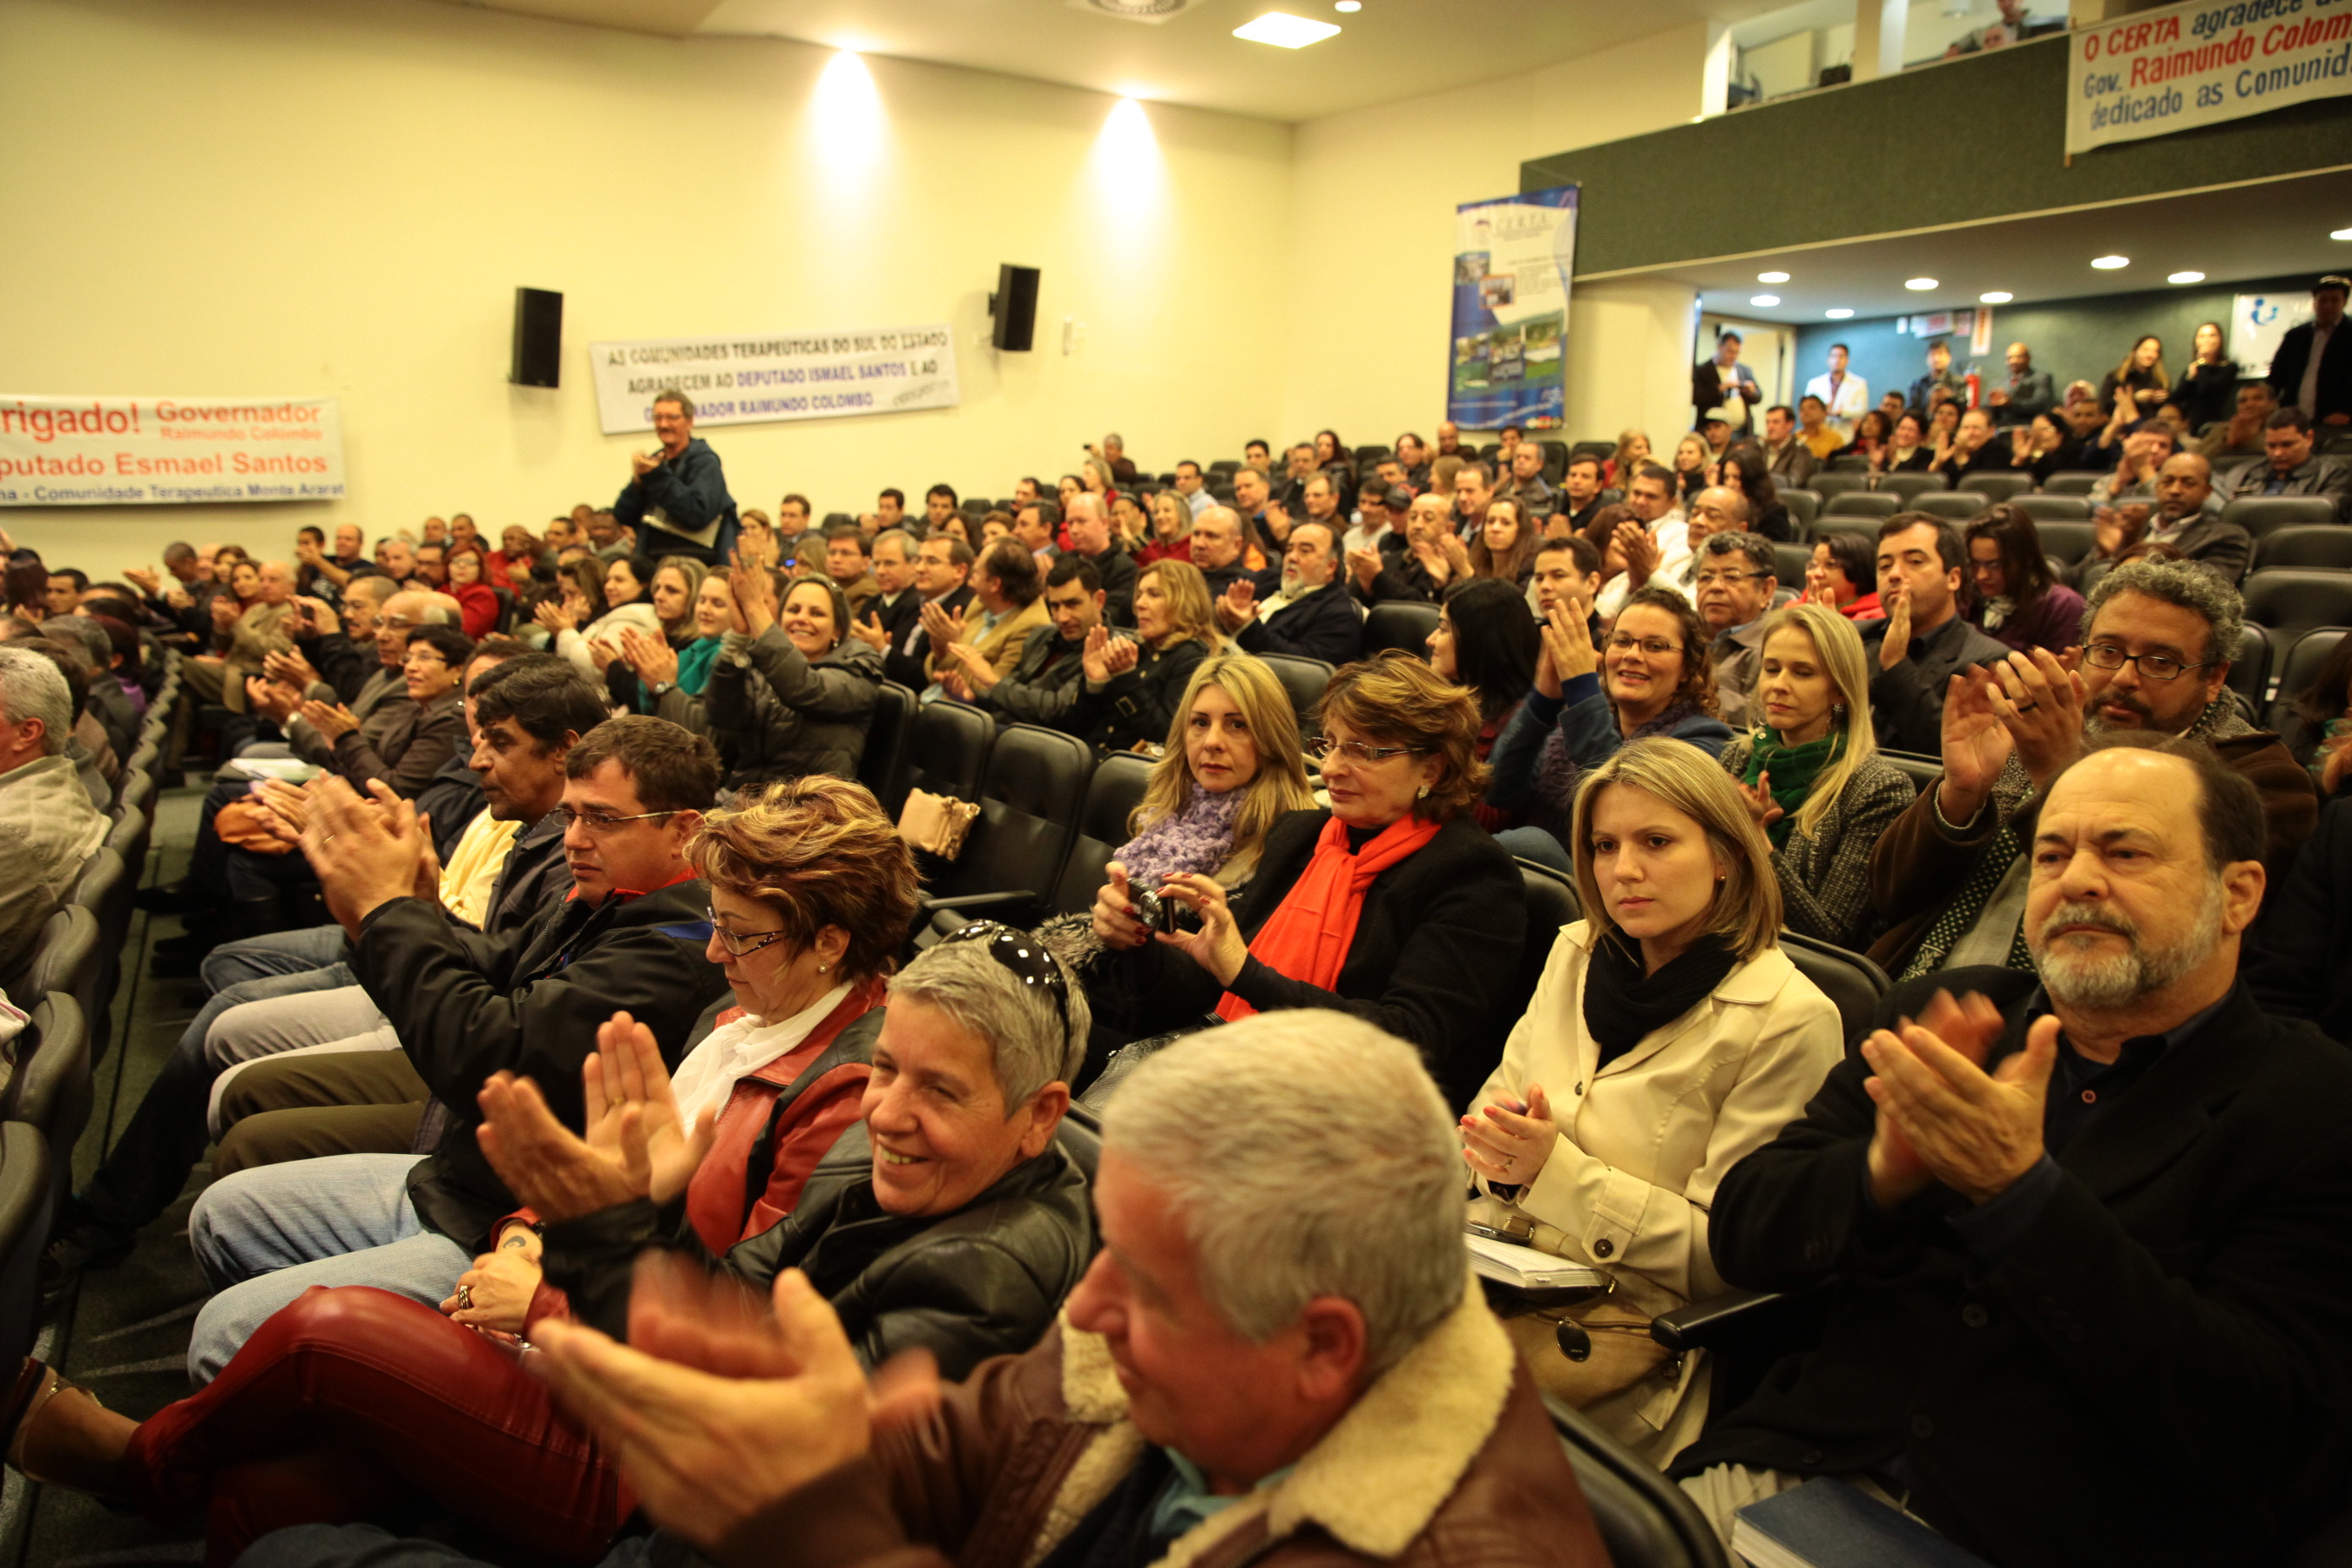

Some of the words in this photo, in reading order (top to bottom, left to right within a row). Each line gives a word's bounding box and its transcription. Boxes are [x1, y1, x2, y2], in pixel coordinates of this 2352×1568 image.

[2084, 34, 2100, 62] O
[2106, 15, 2180, 56] CERTA
[2083, 72, 2122, 98] Gov.
[2130, 29, 2256, 88] Raimundo
[2262, 12, 2352, 57] Colom
[2091, 86, 2183, 130] dedicado
[2197, 81, 2224, 107] as
[2235, 42, 2352, 98] Comunid
[832, 335, 850, 353] DO
[853, 335, 874, 351] SUL
[881, 335, 897, 350] DO
[901, 331, 948, 349] ESTADO
[628, 375, 710, 394] AGRADECEM
[715, 372, 733, 387] AO
[737, 368, 805, 387] DEPUTADO
[808, 365, 855, 382] ISMAEL
[858, 362, 906, 379] SANTOS
[922, 359, 938, 373] AO
[155, 401, 321, 422] Governador
[739, 395, 808, 414] RAIMUNDO
[812, 392, 874, 409] COLOMBO
[160, 426, 247, 440] Raimundo
[251, 425, 323, 440] Colombo
[116, 452, 223, 476] Esmael
[232, 452, 328, 474] Santos
[34, 485, 144, 501] Comunidade
